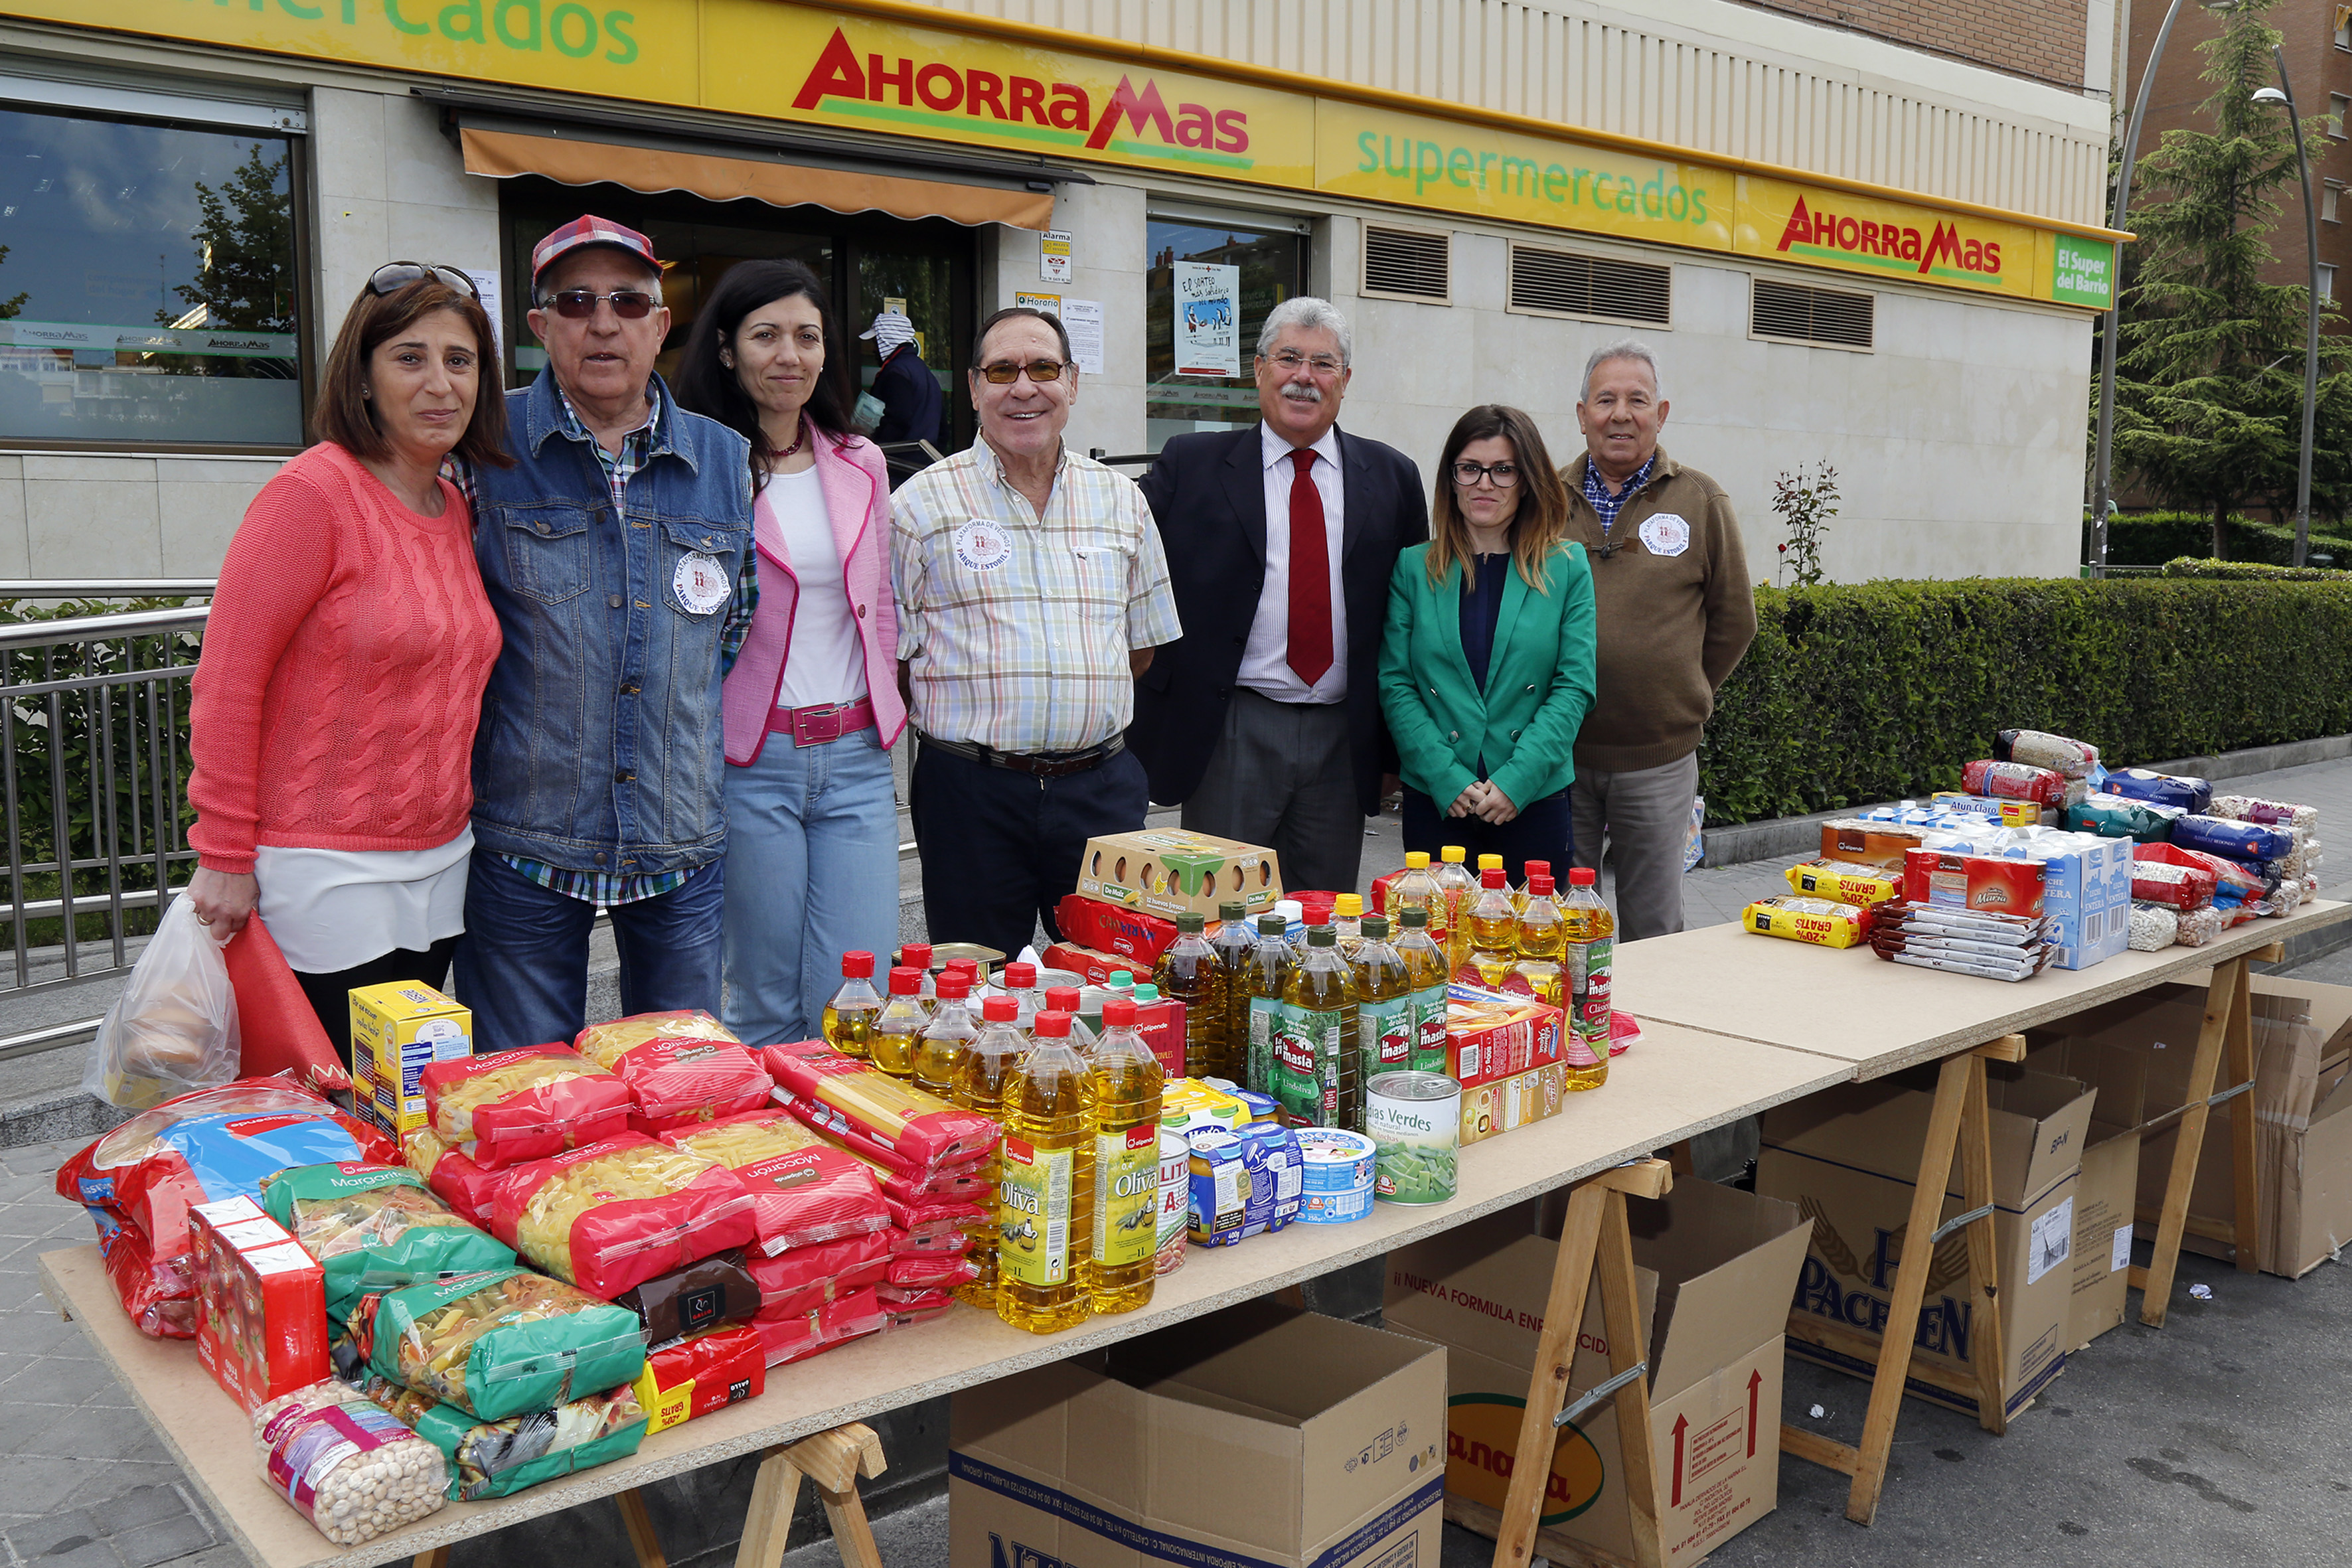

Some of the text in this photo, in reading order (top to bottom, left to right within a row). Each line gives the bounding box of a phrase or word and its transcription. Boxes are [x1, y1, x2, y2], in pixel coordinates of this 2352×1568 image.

[1357, 130, 1707, 226] supermercados
[2058, 249, 2106, 277] El Super
[2057, 272, 2108, 295] del Barrio
[1026, 297, 1058, 307] Horario
[1644, 515, 1669, 533] PLATAFORMA
[1676, 518, 1688, 538] VECINOS
[956, 520, 984, 545] PLATAFORMA
[994, 525, 1010, 548] VECINOS
[1644, 534, 1662, 553] PARQUE
[1663, 543, 1685, 554] ESTORIL
[957, 548, 979, 570] PARQUE
[980, 554, 1008, 570] ESTORIL
[676, 552, 729, 589] PLATAFORMA DE VECINOS
[676, 583, 699, 612] PARQUE
[701, 595, 728, 613] ESTORIL
[1950, 801, 1997, 814] Atún Claro
[2193, 834, 2213, 843] ARROZ
[1105, 886, 1113, 894] De
[1839, 880, 1876, 895] GRATIS
[2113, 879, 2125, 890] LECHE
[1842, 892, 1871, 905] +20%
[2088, 888, 2102, 898] LECHE
[2109, 892, 2128, 904] ENTERA
[1152, 898, 1168, 908] huevos
[1169, 902, 1187, 911] frescos
[2085, 900, 2104, 911] ENTERA
[1099, 914, 1156, 942] MARÍA ORO
[1795, 918, 1832, 933] GRATIS
[1796, 930, 1827, 942] +20%
[1499, 986, 1537, 1002] Carbonell
[1589, 1003, 1610, 1014] Clásico
[1144, 1022, 1168, 1032] alipende
[1294, 1027, 1307, 1037] oliva
[1421, 1028, 1446, 1046] masía
[675, 1046, 702, 1058] alipende
[1283, 1041, 1289, 1052] la
[1381, 1040, 1409, 1059] masía
[1283, 1049, 1312, 1069] masía
[1421, 1058, 1445, 1070] Lindoliva
[1166, 1068, 1174, 1079] DE
[1283, 1078, 1312, 1095] Lindoliva
[230, 1115, 289, 1128] alipende
[1387, 1107, 1431, 1132] Verdes
[1379, 1122, 1401, 1131] natural
[1135, 1137, 1154, 1146] alipende
[1376, 1131, 1399, 1142] Anchas
[752, 1152, 803, 1168] Calidad Superior
[1012, 1152, 1032, 1163] alipende
[747, 1152, 822, 1178] Macarrón
[1141, 1166, 1156, 1176] Aceite
[774, 1170, 803, 1183] alipende
[1017, 1184, 1035, 1196] Aceite
[1115, 1171, 1158, 1198] Oliva
[1000, 1181, 1040, 1215] Oliva
[1227, 1231, 1240, 1239] 400g
[1404, 1272, 1514, 1325] NUEVA FORMULA
[692, 1308, 712, 1320] GALLO
[200, 1333, 211, 1354] Frito
[198, 1343, 216, 1372] Tomate
[224, 1359, 238, 1380] Frito
[223, 1369, 244, 1398] Tomate
[730, 1379, 749, 1391] GALLO
[661, 1401, 684, 1417] GRATIS
[703, 1397, 728, 1409] PLUMAS
[662, 1414, 680, 1426] +20%
[961, 1460, 982, 1479] (GIRONA)
[984, 1469, 1011, 1487] VILAMALLA
[1011, 1479, 1027, 1494] 527123
[1027, 1486, 1036, 1496] 972
[1036, 1490, 1042, 1500] 34
[1044, 1493, 1051, 1503] 00
[1089, 1512, 1096, 1523] 34
[1097, 1516, 1103, 1526] 00
[1158, 1539, 1206, 1564] INTERNACIONAL
